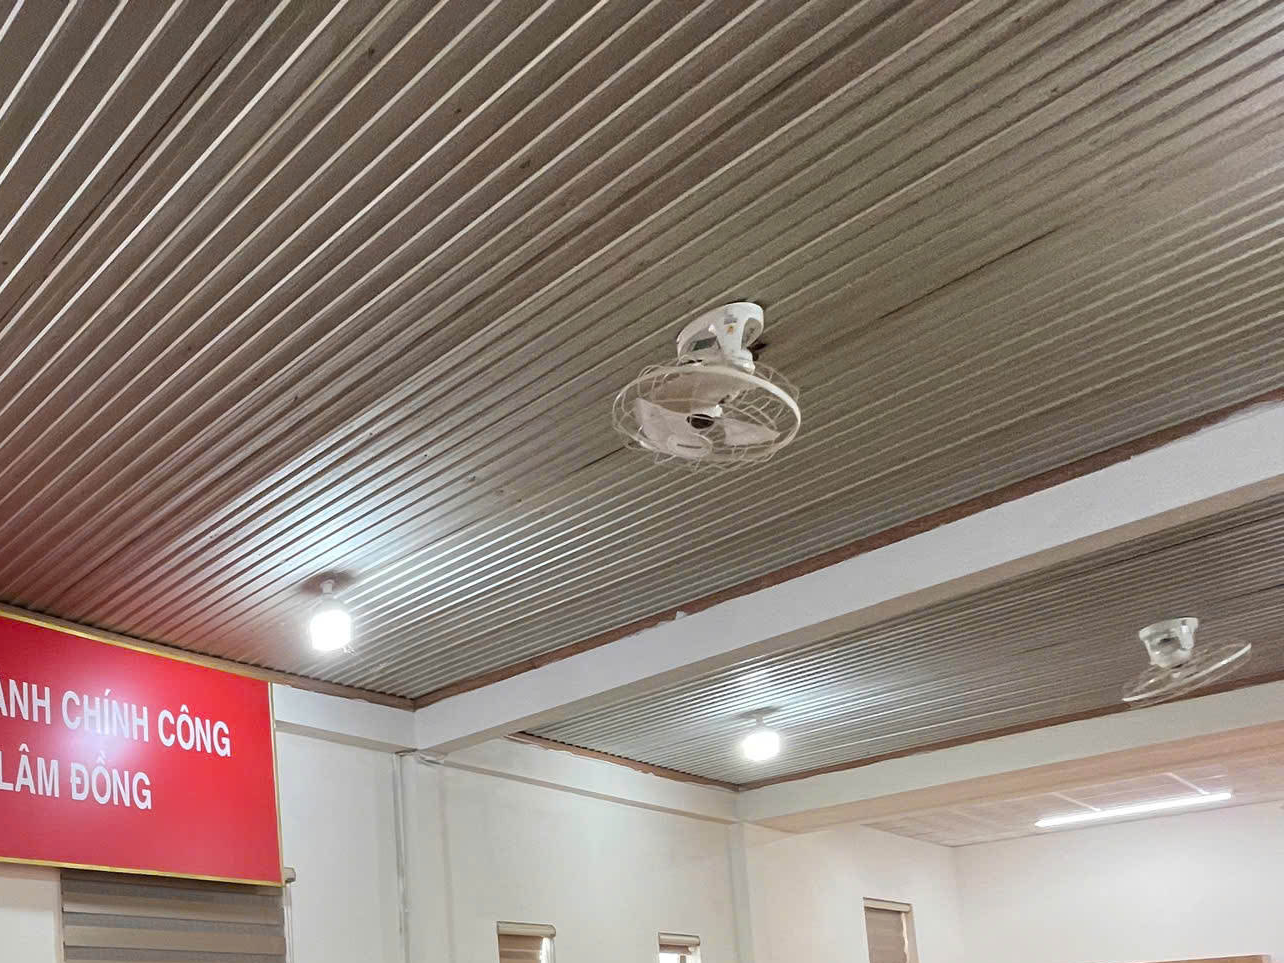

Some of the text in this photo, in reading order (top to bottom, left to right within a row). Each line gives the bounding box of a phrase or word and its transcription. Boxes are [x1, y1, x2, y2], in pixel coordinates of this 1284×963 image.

[61, 688, 149, 743] CHÍNH
[157, 704, 231, 757] CÔNG
[69, 750, 152, 810] ĐỒNG
